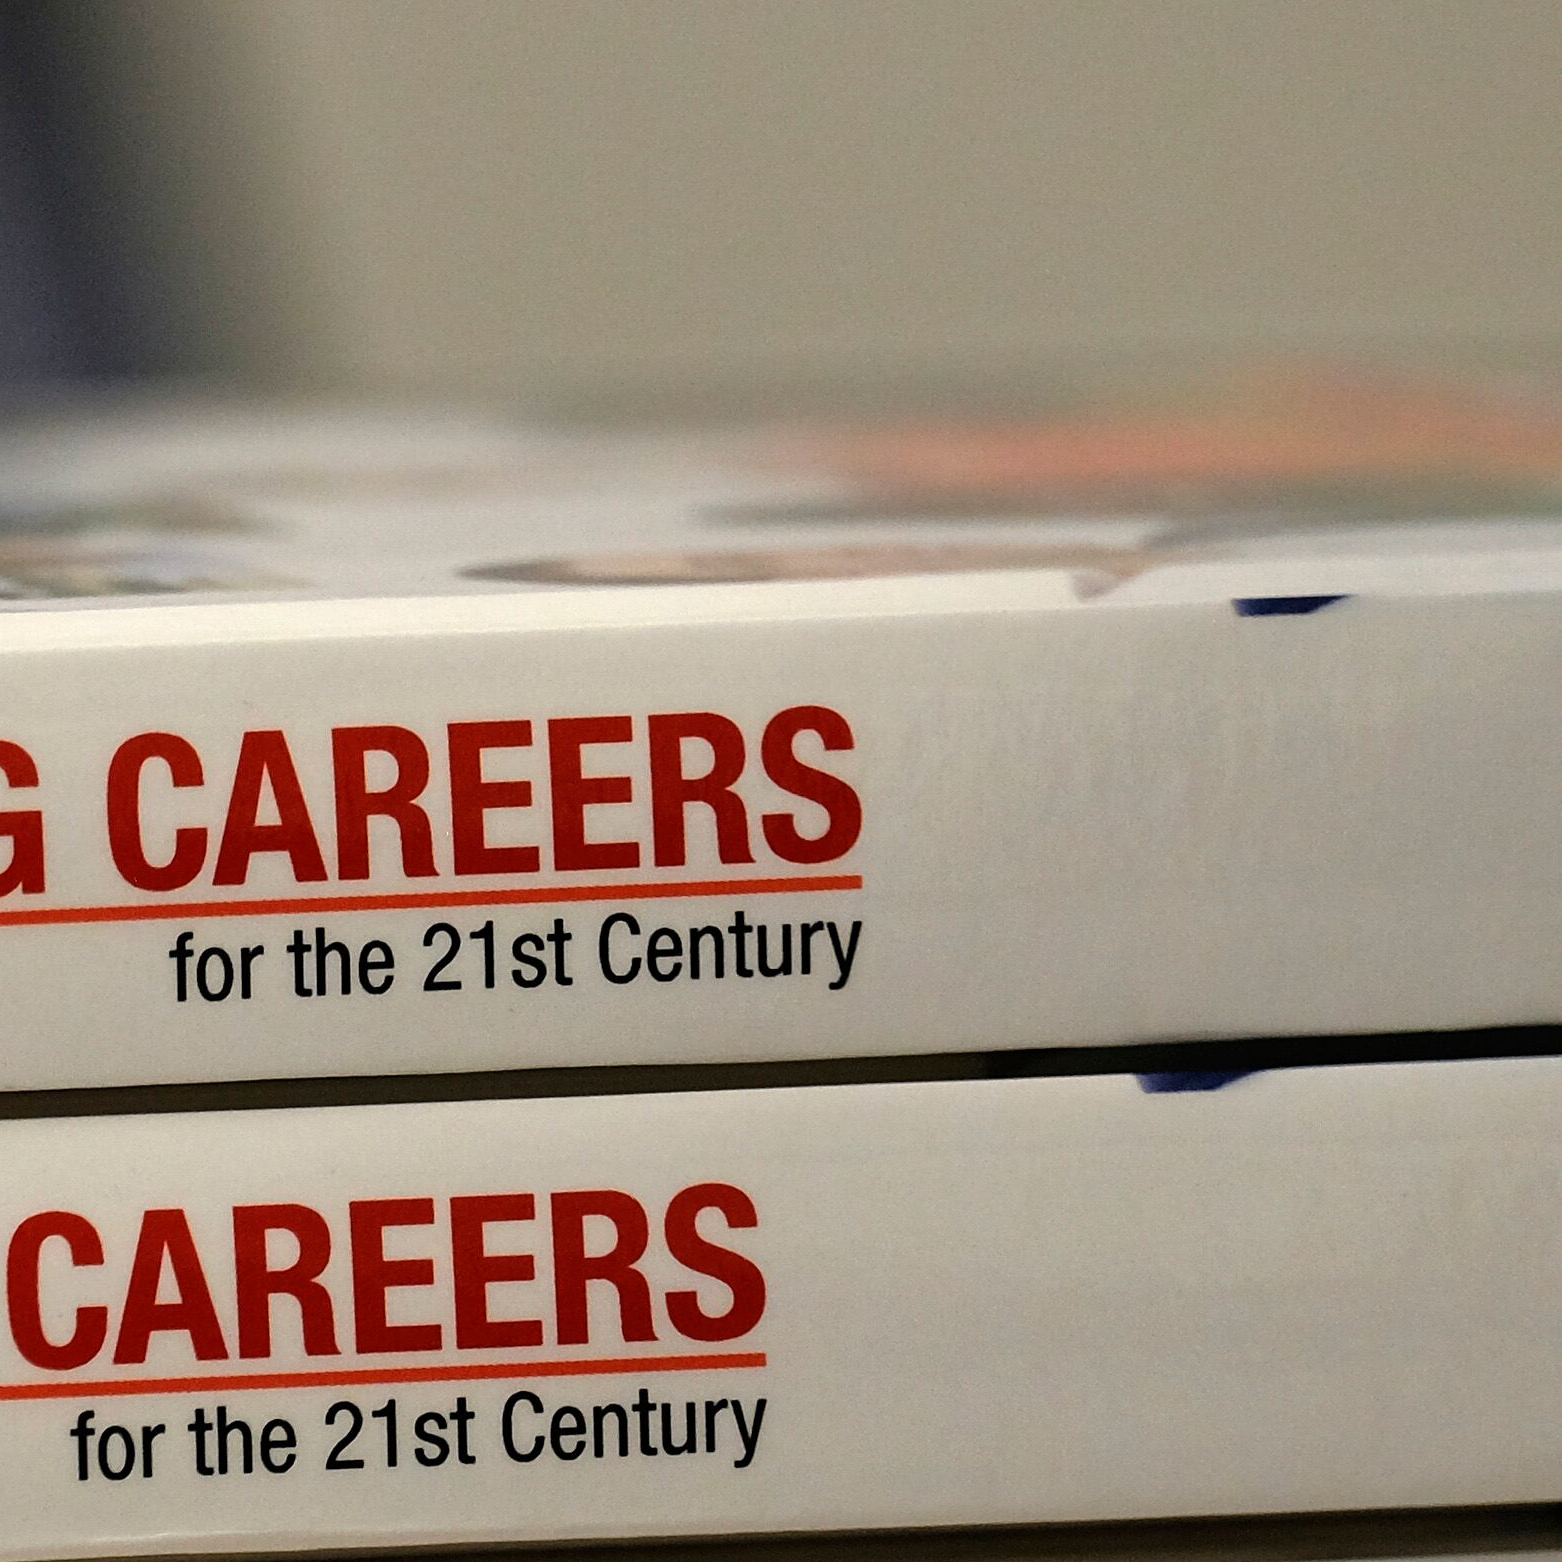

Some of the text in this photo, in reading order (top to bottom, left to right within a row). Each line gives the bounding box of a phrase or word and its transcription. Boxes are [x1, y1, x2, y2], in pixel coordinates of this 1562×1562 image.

[107, 705, 864, 892] CAREERS
[169, 910, 863, 1003] for the 21st Century
[7, 1182, 768, 1371] CAREERS
[69, 1388, 768, 1482] for the 21st Century
